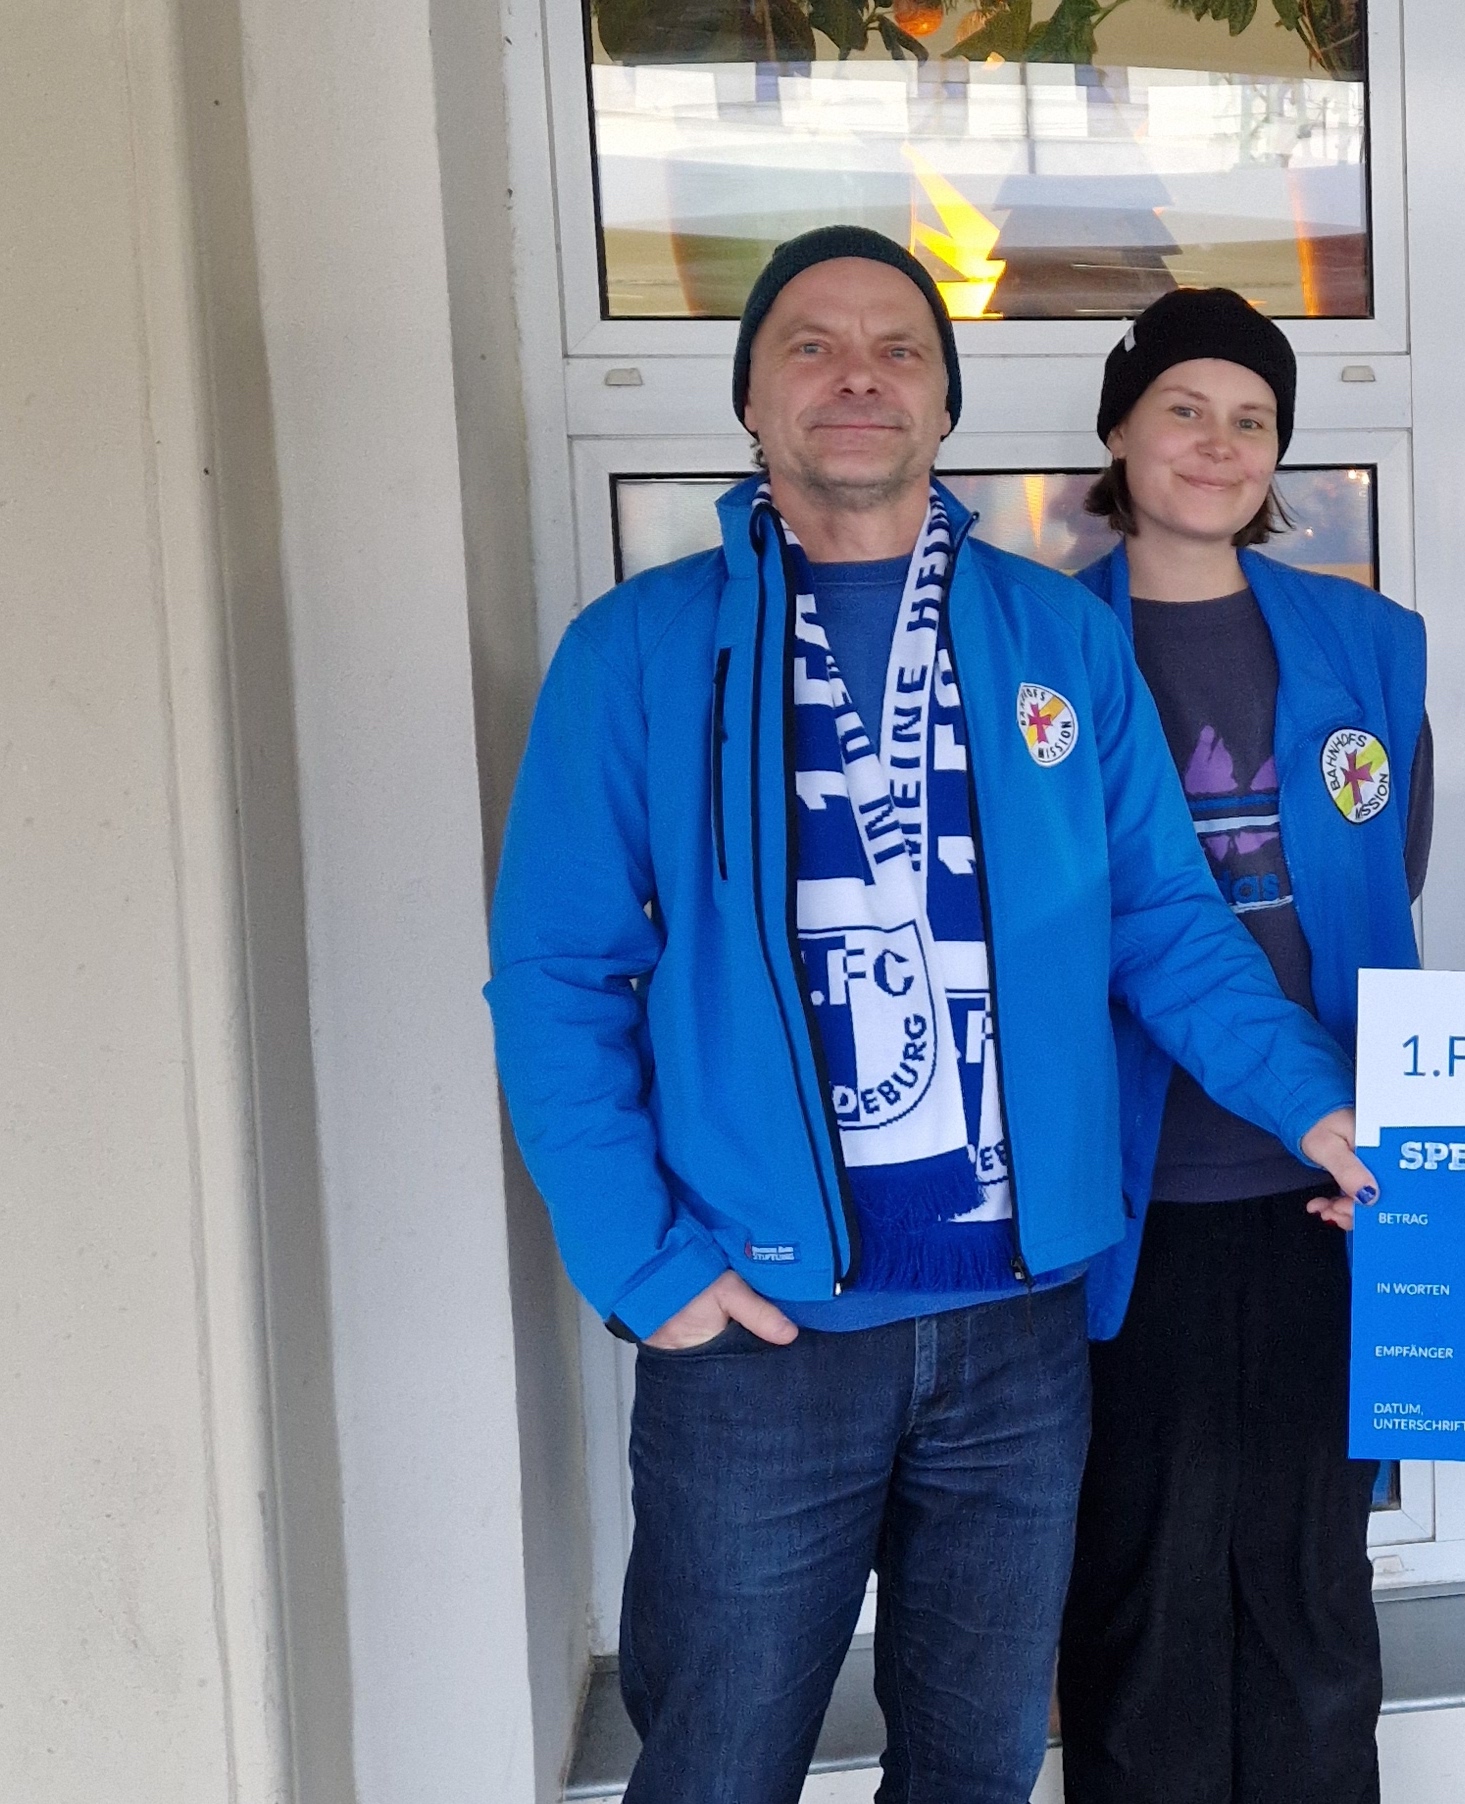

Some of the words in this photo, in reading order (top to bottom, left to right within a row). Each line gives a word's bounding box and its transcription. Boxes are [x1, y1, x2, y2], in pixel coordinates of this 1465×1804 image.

[1327, 733, 1367, 791] BAHNHOFS
[1378, 1212, 1429, 1225] BETRAG
[1376, 1282, 1391, 1294] IN
[1393, 1283, 1450, 1296] WORTEN
[1374, 1344, 1454, 1359] EMPFÄNGER
[1373, 1402, 1424, 1416] DATUM,
